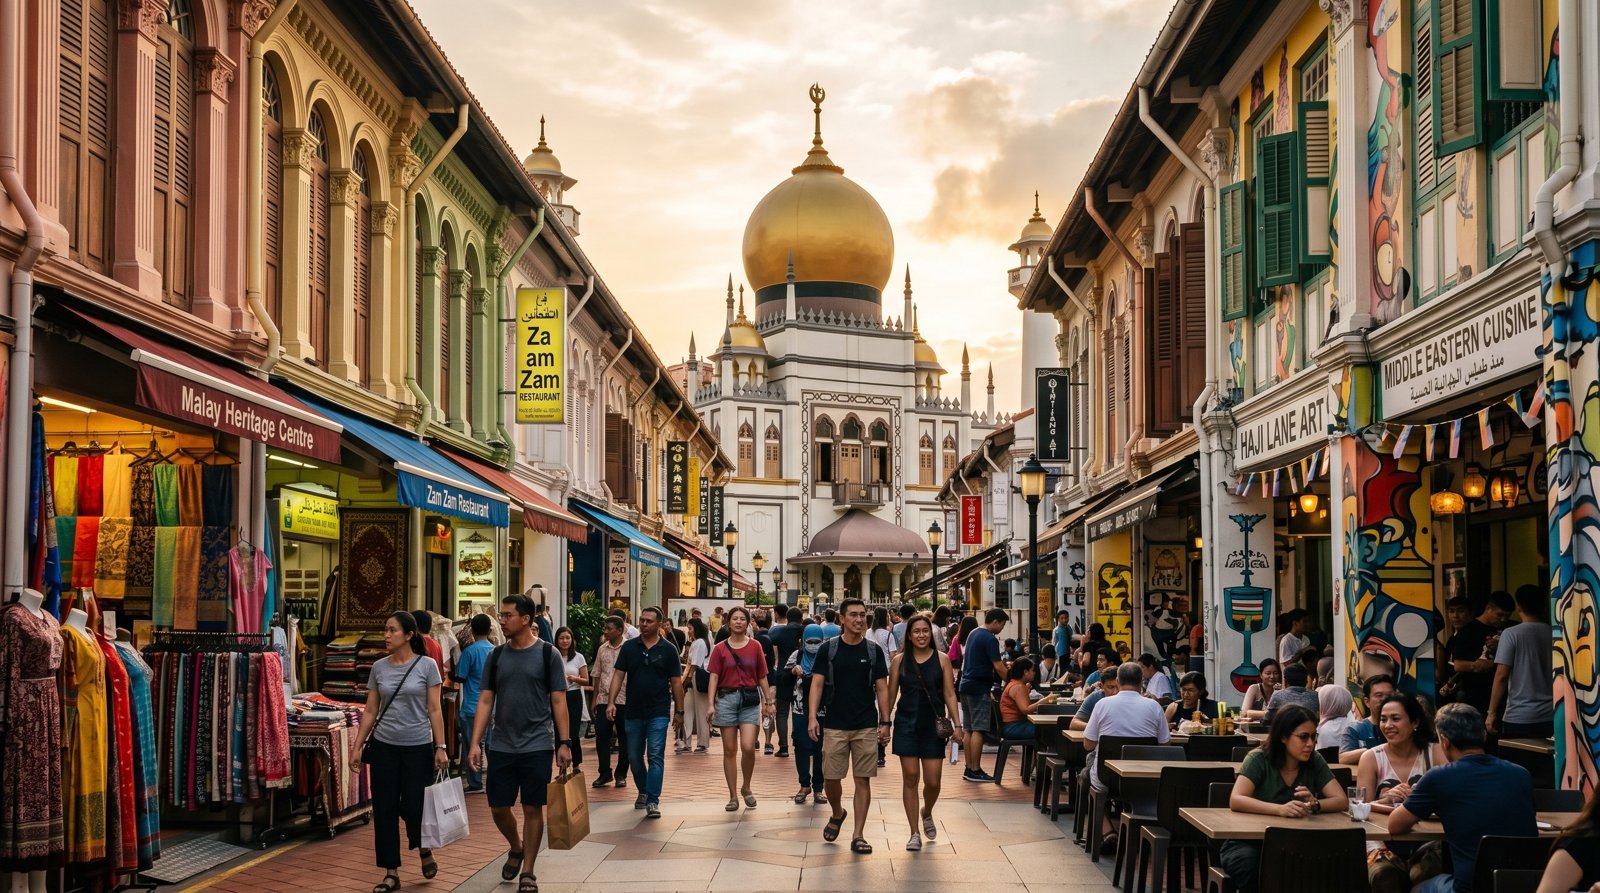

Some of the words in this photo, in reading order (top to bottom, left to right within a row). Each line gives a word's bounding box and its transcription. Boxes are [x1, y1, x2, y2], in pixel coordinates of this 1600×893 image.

[527, 326, 551, 345] Za
[1384, 348, 1423, 390] MIDDLE
[1425, 322, 1480, 373] EASTERN
[1483, 294, 1538, 348] CUISINE
[526, 351, 554, 367] am
[520, 370, 560, 389] Zam
[519, 392, 561, 401] RESTAURANT
[182, 385, 221, 427] Malay
[225, 400, 275, 441] Heritage
[279, 419, 314, 449] Centre
[1240, 424, 1264, 460] HAJI
[1267, 409, 1297, 451] LANE
[1299, 398, 1324, 439] ART
[427, 484, 442, 506] Zam
[443, 489, 457, 510] Zam
[458, 493, 489, 518] Restaurant
